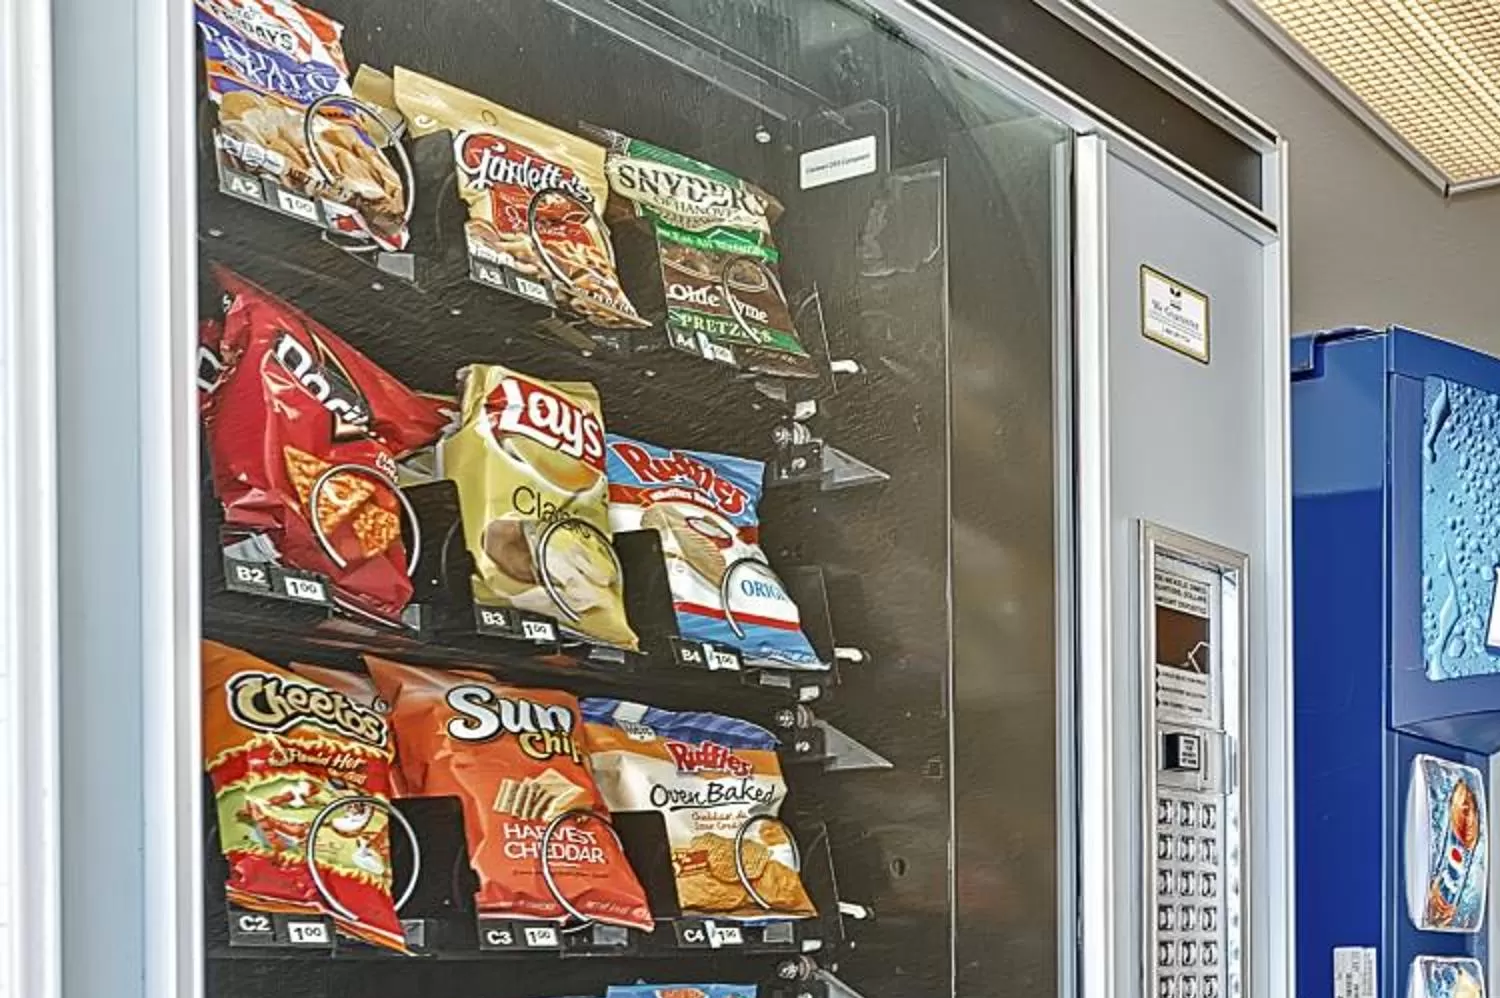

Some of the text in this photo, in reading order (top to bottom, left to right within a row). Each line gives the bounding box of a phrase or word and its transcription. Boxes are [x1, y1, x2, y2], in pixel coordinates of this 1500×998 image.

[231, 177, 260, 198] A2
[479, 269, 503, 285] A3
[667, 284, 721, 307] Olde
[680, 313, 772, 343] PRETZS
[611, 442, 749, 515] Ruffles
[237, 566, 266, 583] B2
[741, 579, 788, 602] ORIG
[481, 611, 505, 627] B3
[234, 675, 384, 743] Cheetos
[447, 685, 573, 741] Sun
[665, 741, 753, 778] Ruffles
[650, 778, 776, 808] Oven Baked
[239, 916, 271, 932] C2
[487, 930, 512, 945] C3
